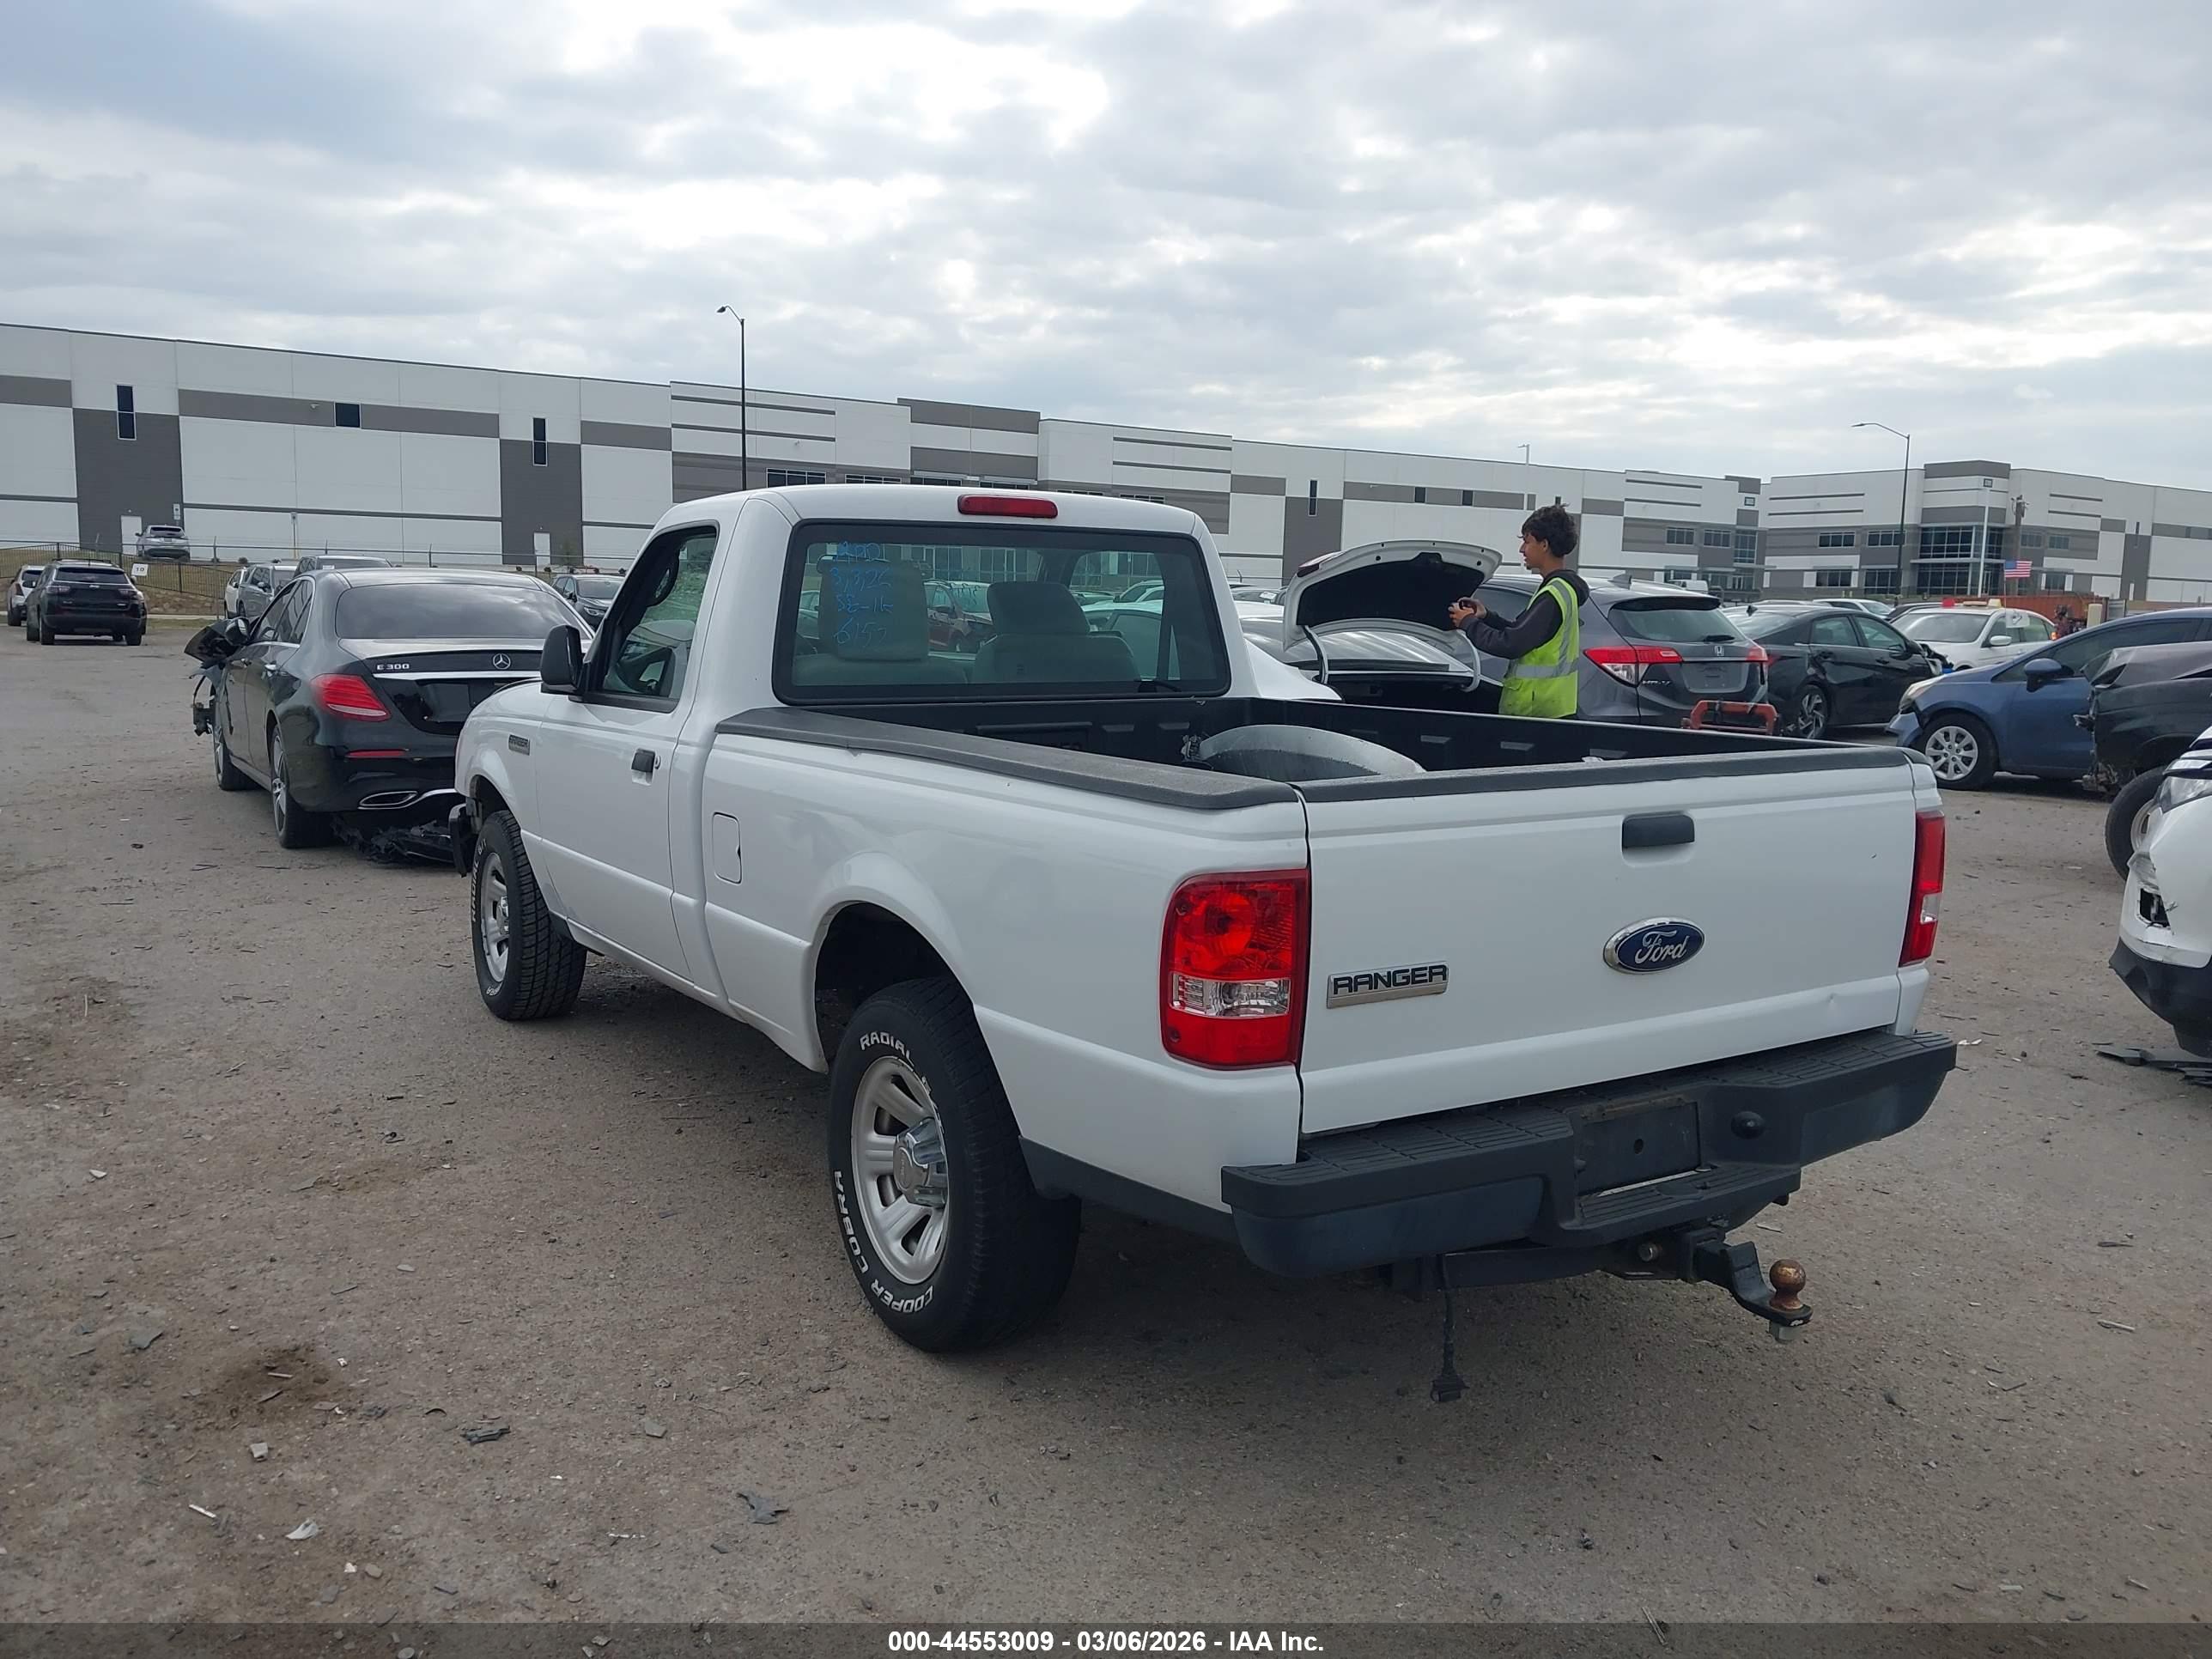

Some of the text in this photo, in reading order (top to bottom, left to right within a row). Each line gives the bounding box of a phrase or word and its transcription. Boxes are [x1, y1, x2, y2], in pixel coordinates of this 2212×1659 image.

[1633, 930, 1691, 965] Ford
[1333, 963, 1448, 995] RANGER
[860, 1031, 915, 1067] RADIAL
[833, 1170, 934, 1314] COOPER COBRA
